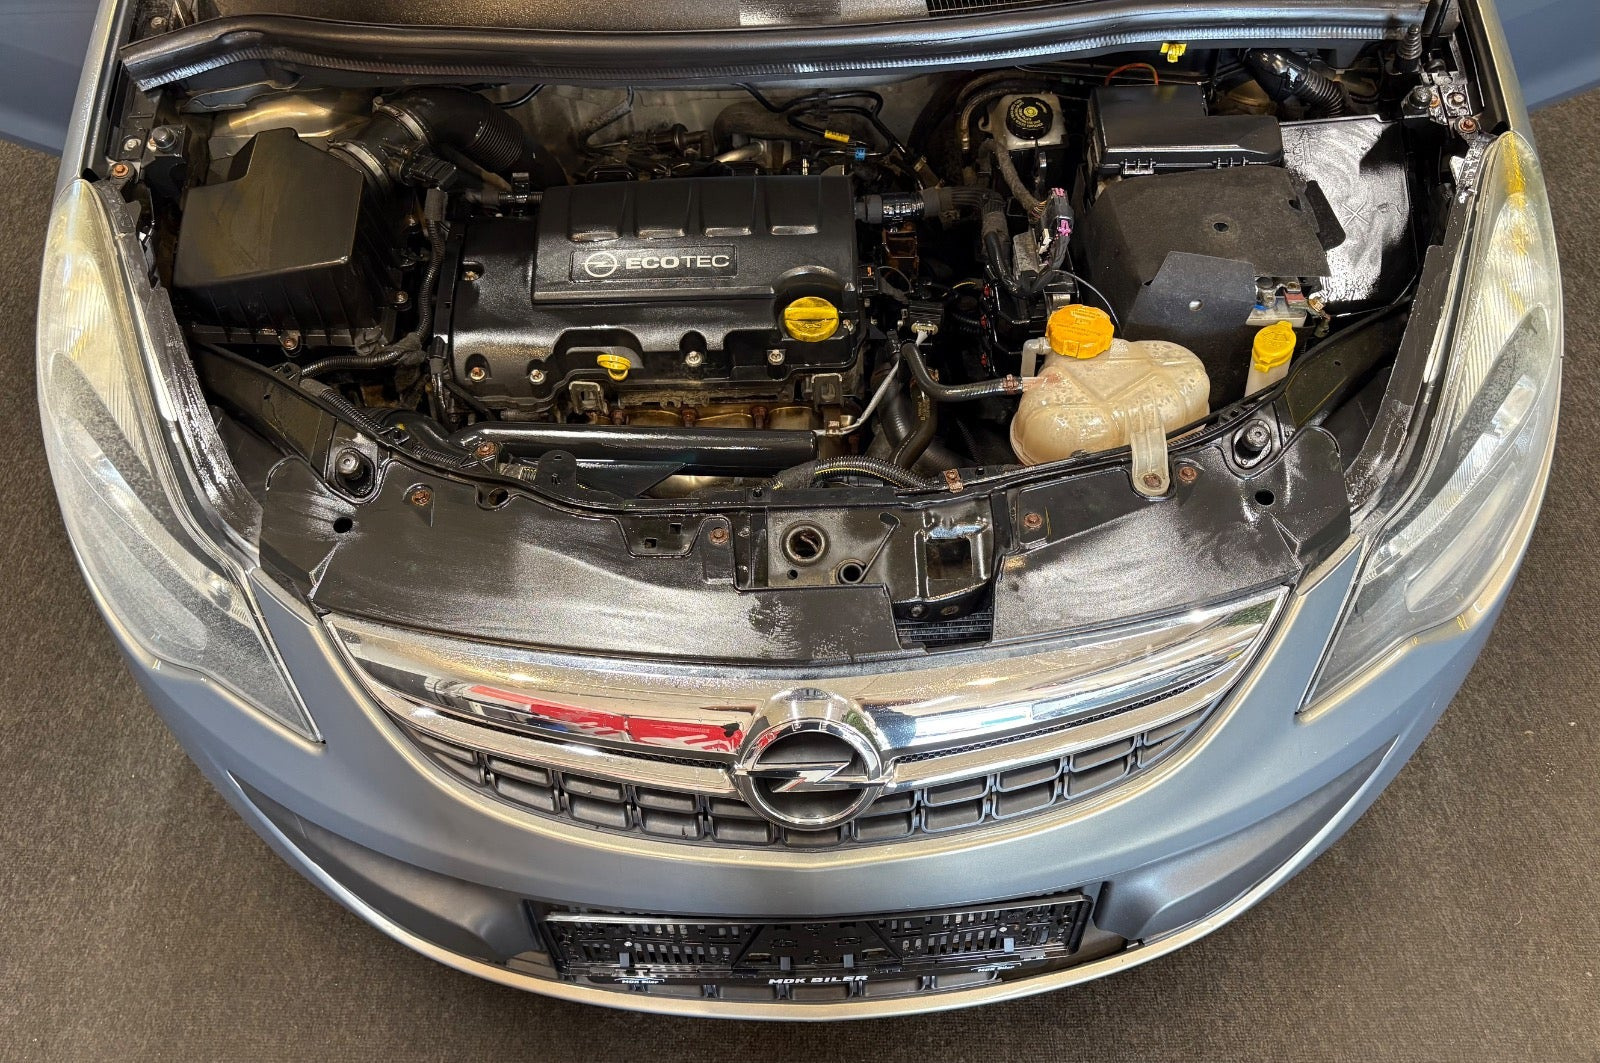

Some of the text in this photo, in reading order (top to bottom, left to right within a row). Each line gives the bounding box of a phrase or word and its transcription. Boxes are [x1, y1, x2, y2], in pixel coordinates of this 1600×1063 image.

[625, 255, 730, 270] ECOTEC
[768, 975, 869, 985] MDK BILER
